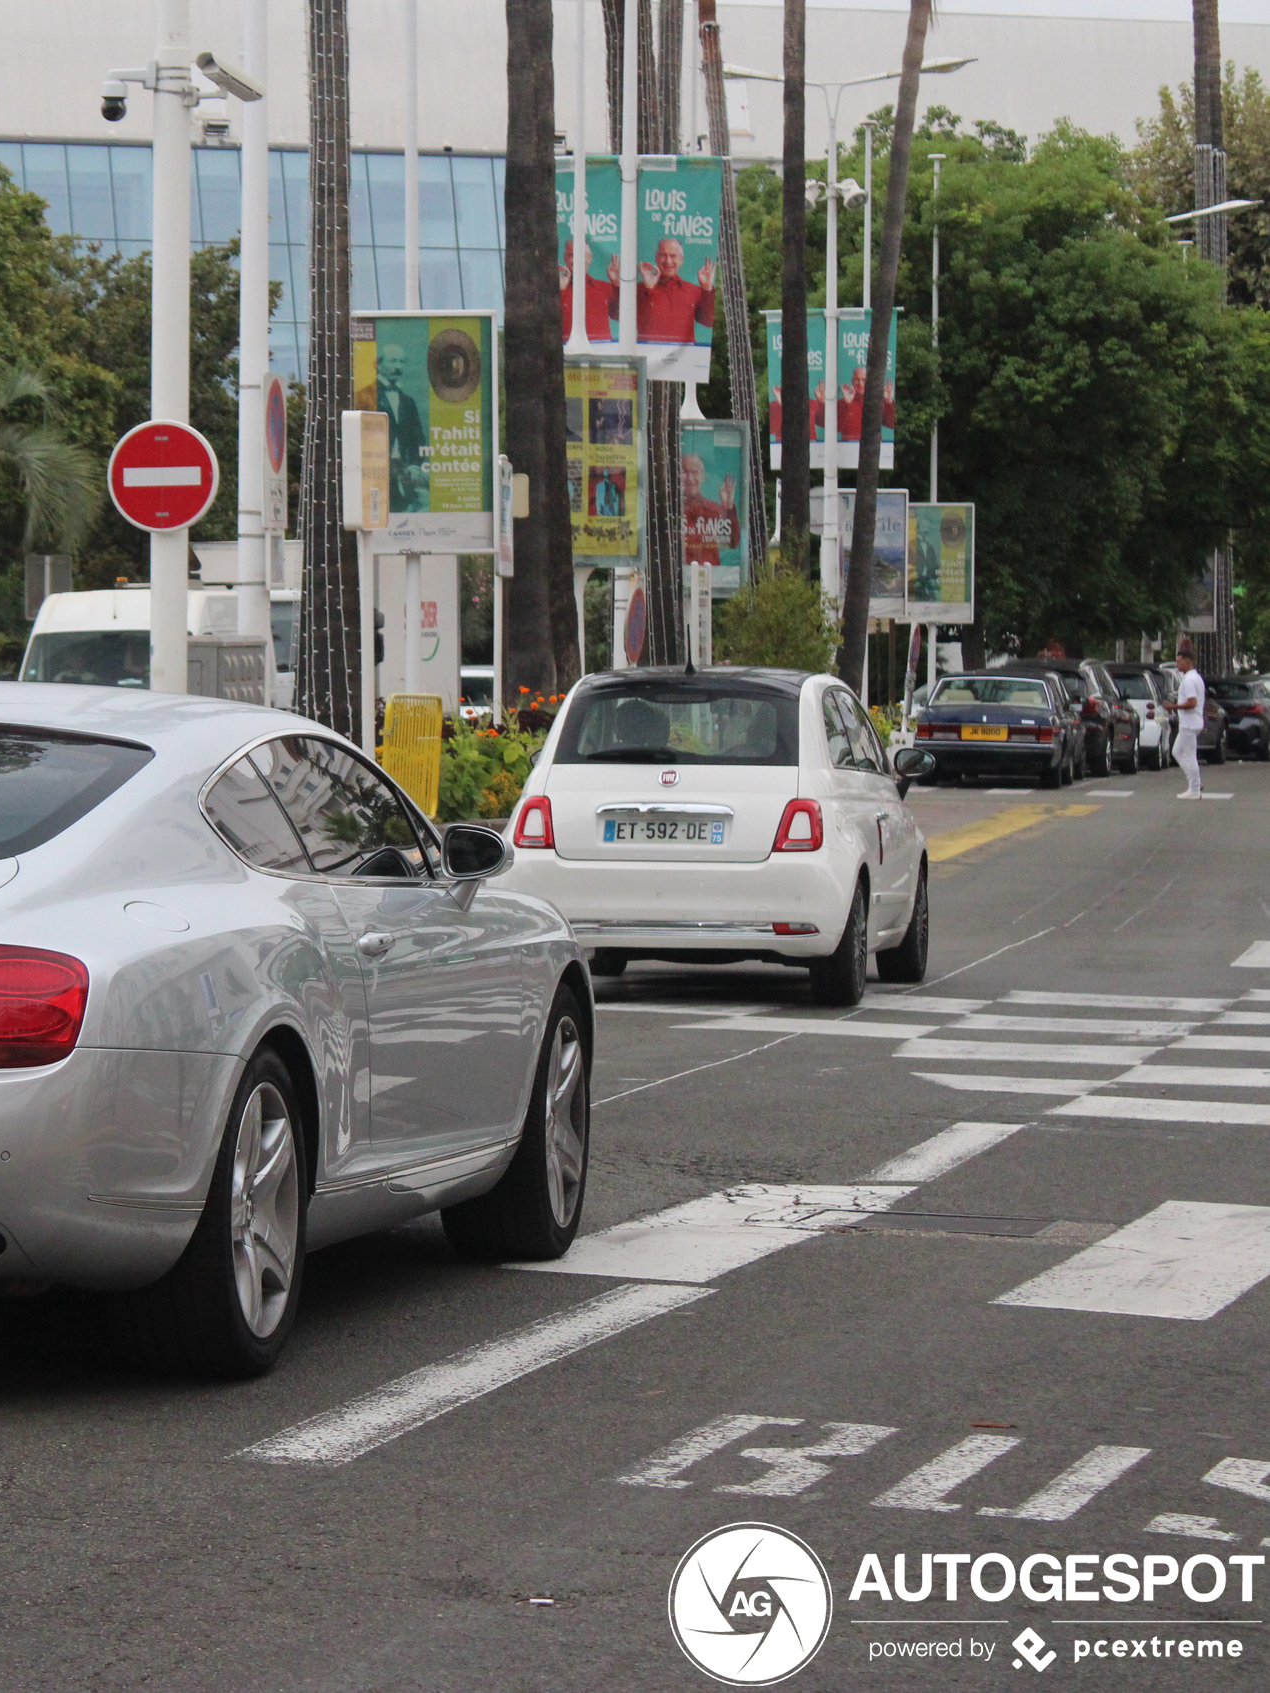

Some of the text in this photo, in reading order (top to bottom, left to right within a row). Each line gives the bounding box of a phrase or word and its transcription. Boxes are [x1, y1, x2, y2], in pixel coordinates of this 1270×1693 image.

[464, 410, 480, 423] Si
[430, 426, 480, 440] Tahiti
[418, 442, 480, 457] m'était
[420, 458, 480, 473] contée
